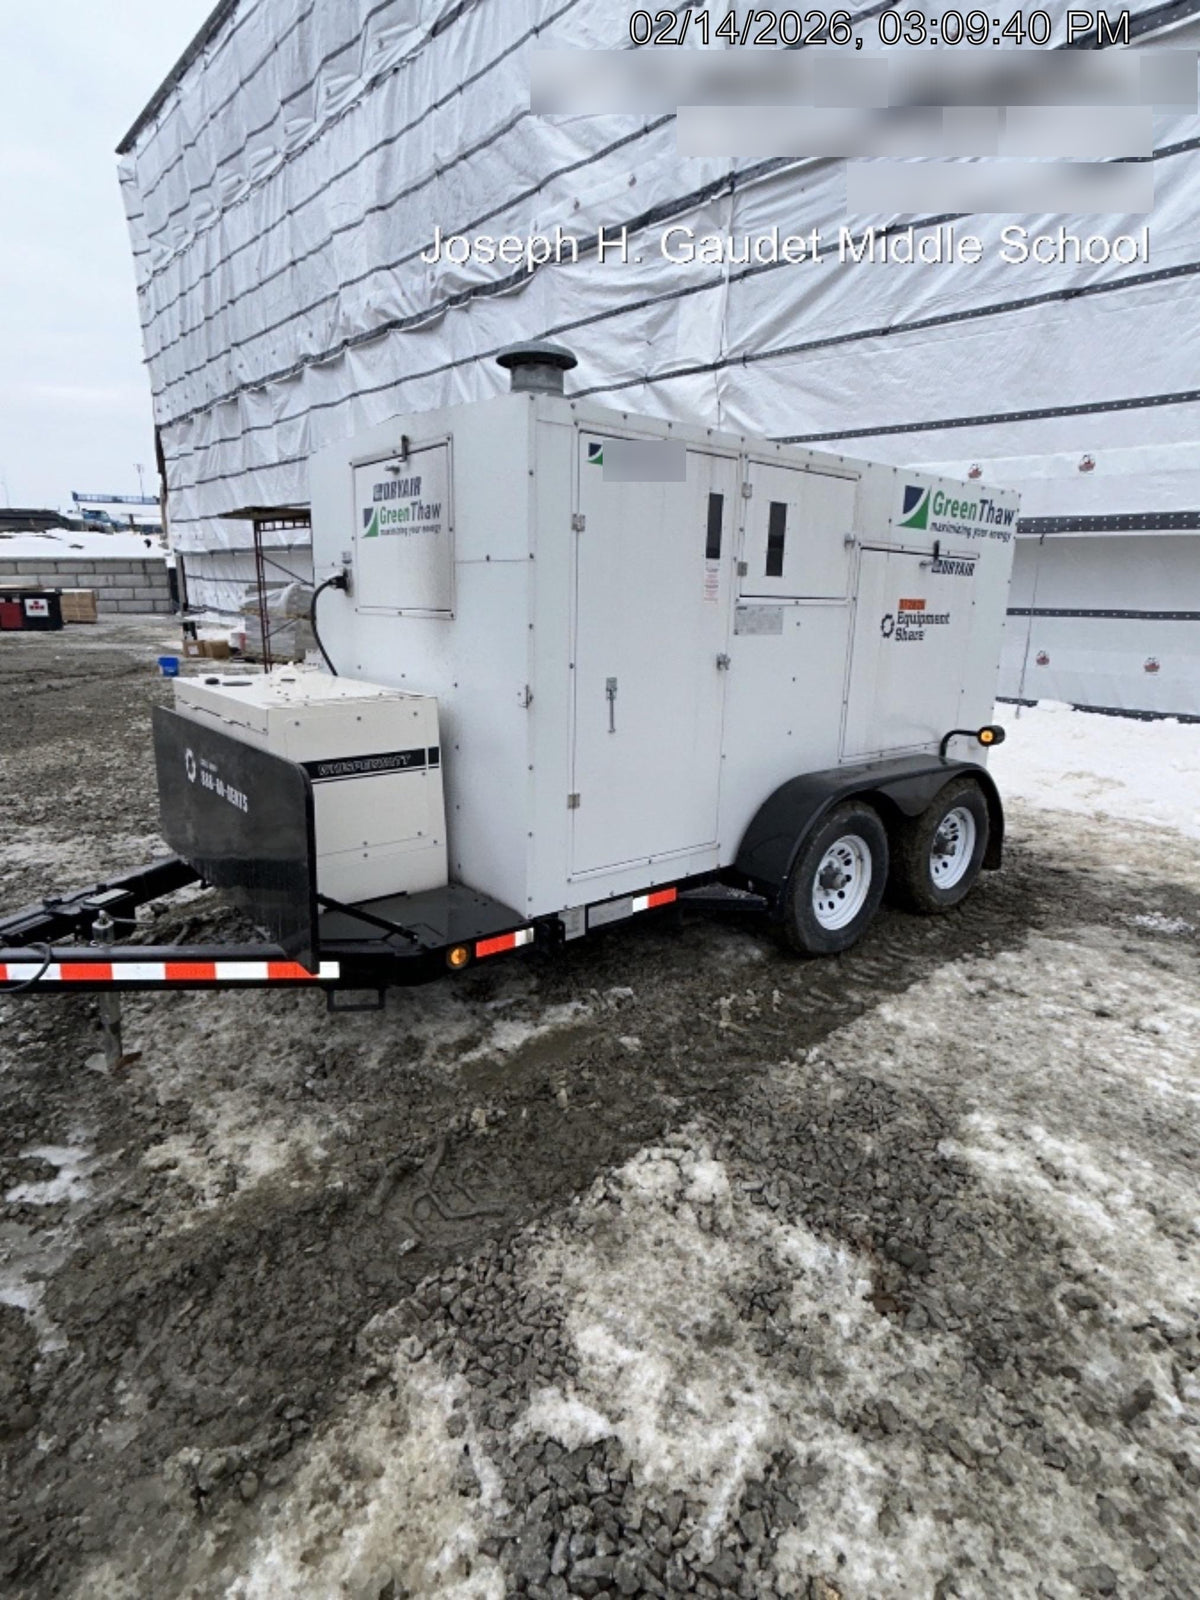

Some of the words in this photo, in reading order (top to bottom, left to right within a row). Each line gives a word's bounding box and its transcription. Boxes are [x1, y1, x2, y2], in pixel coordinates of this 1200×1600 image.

[380, 499, 442, 525] GreenThaw
[933, 490, 1016, 527] GreenThaw
[897, 611, 950, 628] Equipment
[895, 627, 925, 641] Share
